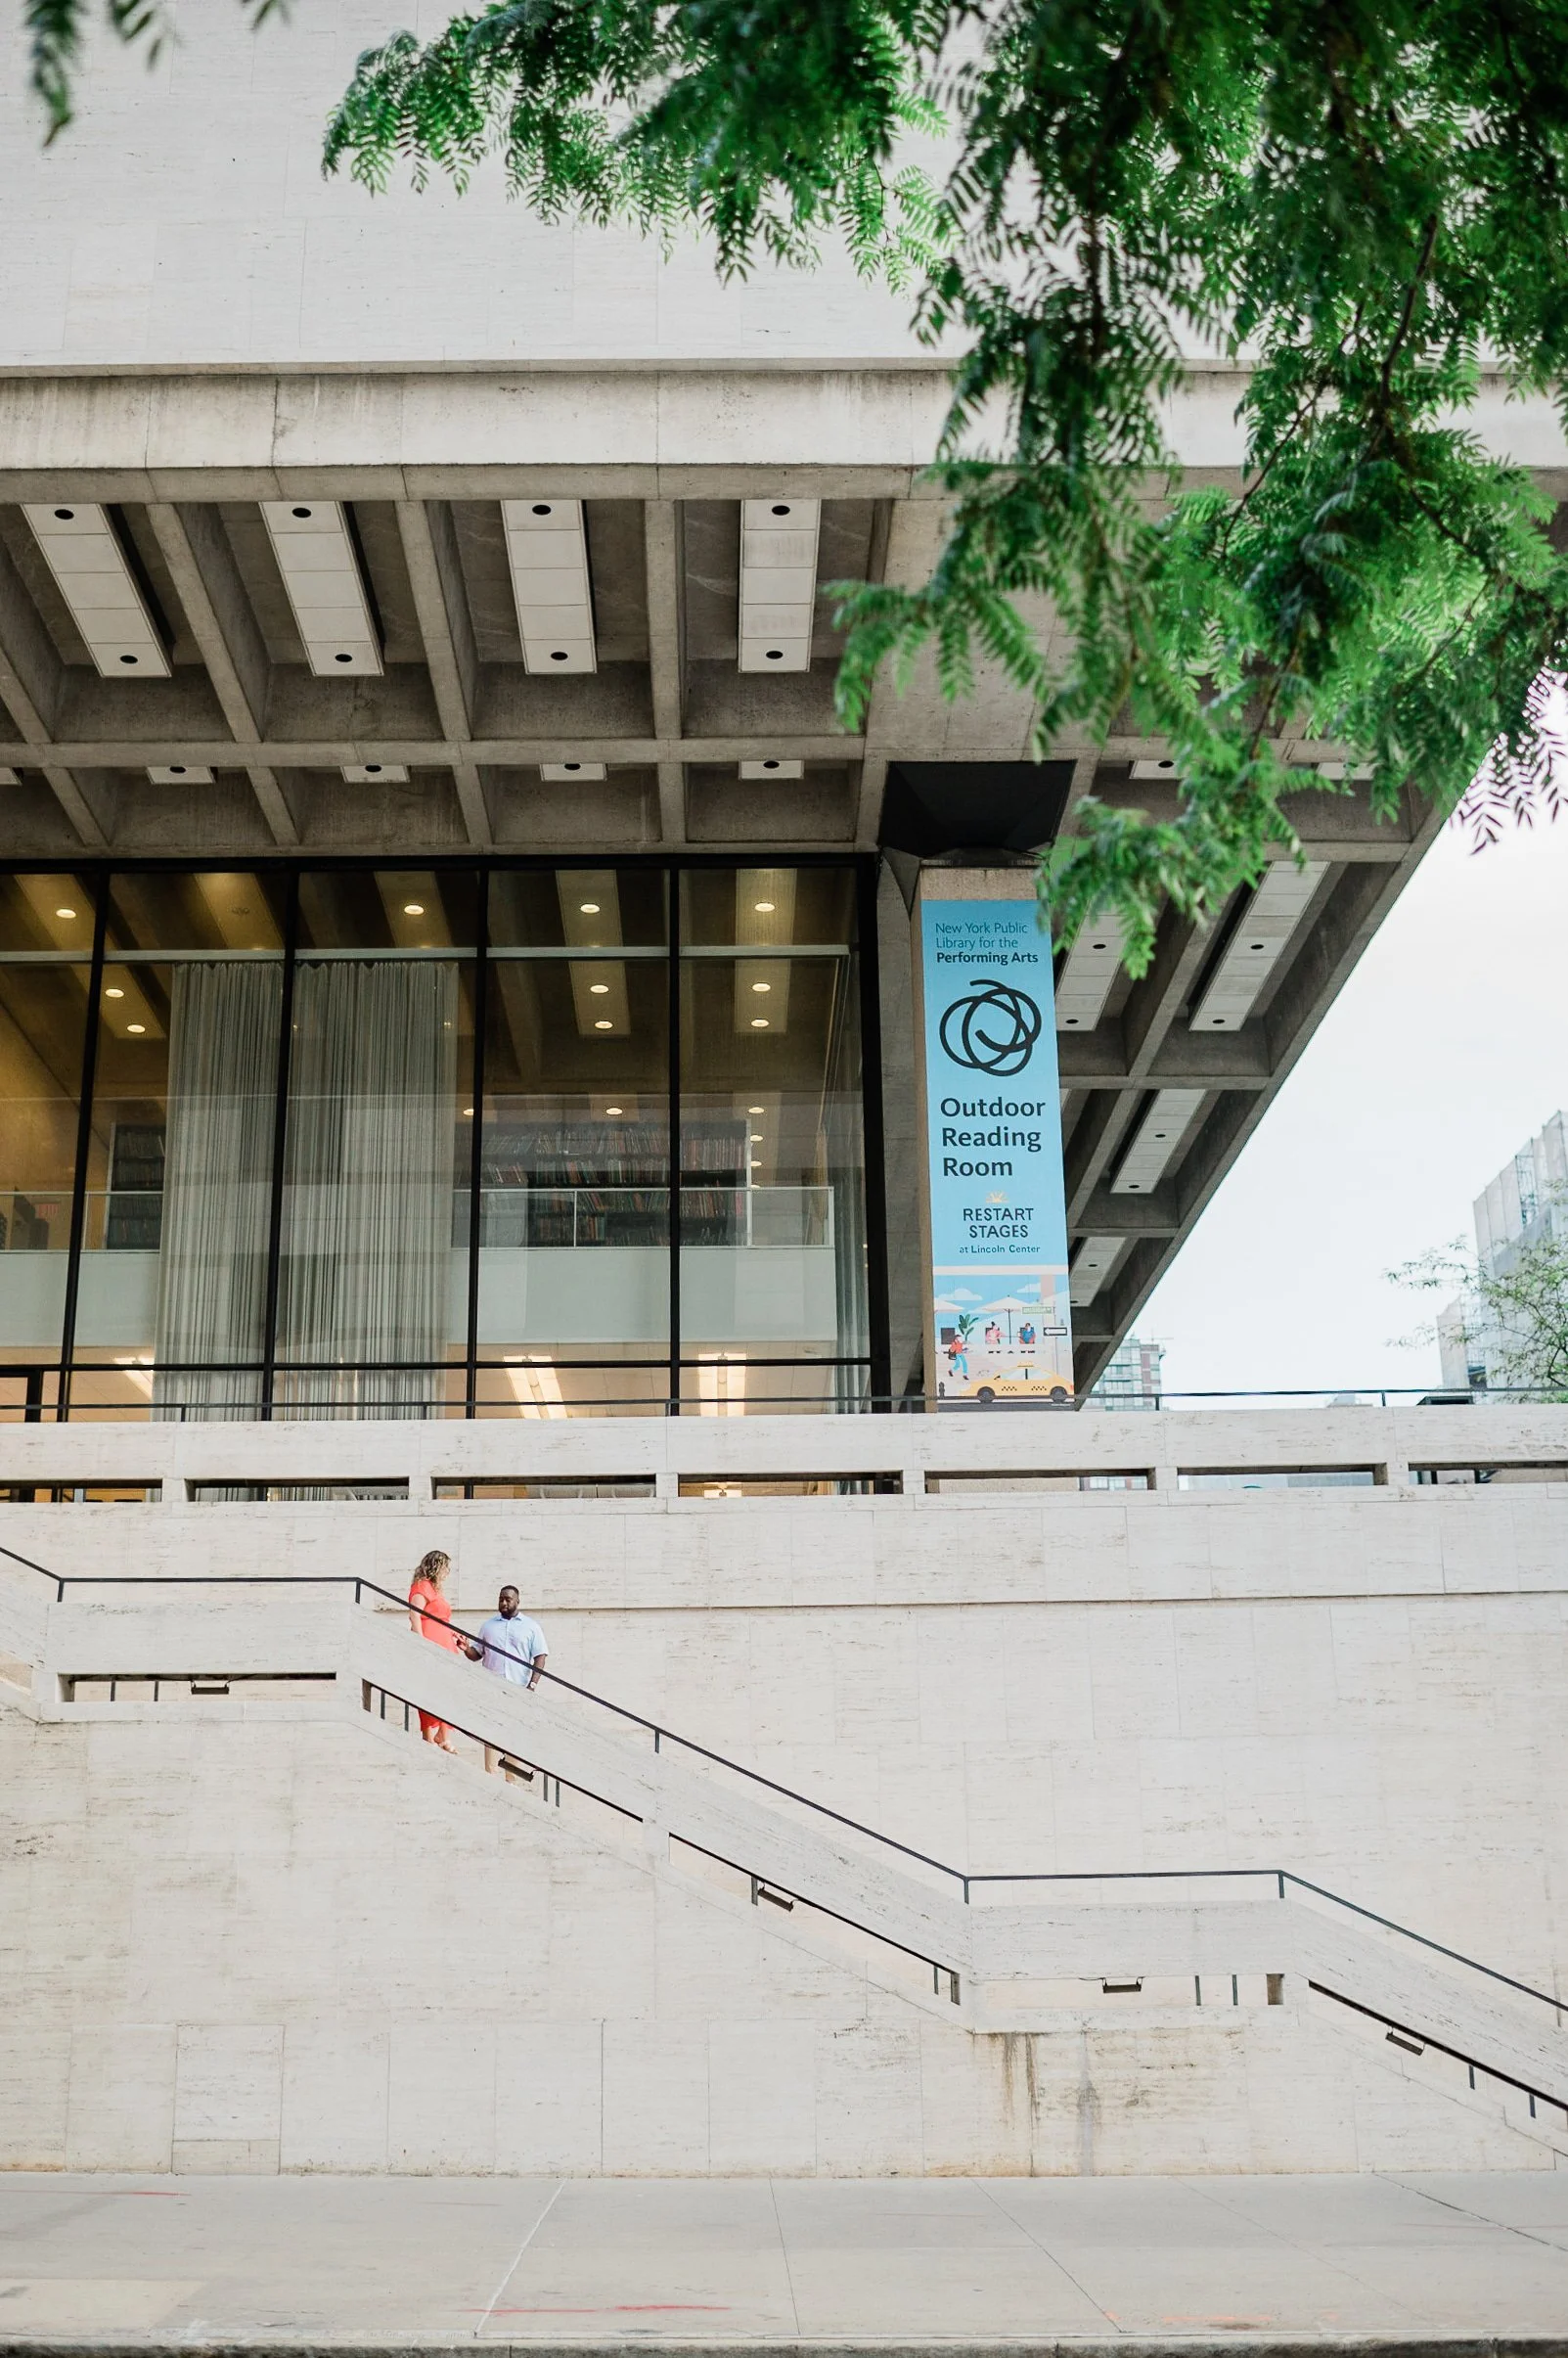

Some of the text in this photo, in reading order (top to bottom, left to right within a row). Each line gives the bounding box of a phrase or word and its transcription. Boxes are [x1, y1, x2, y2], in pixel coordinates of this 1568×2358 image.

[935, 923, 1028, 934] New York Public
[936, 936, 1018, 951] Library for the
[936, 952, 1039, 966] Performing Arts
[940, 1097, 1046, 1117] Outdoor
[942, 1126, 1042, 1153] Reading
[943, 1157, 1013, 1177] Room
[963, 1207, 1034, 1221] RESTART
[969, 1224, 1029, 1239] STAGES
[971, 1245, 1006, 1253] Lincoln
